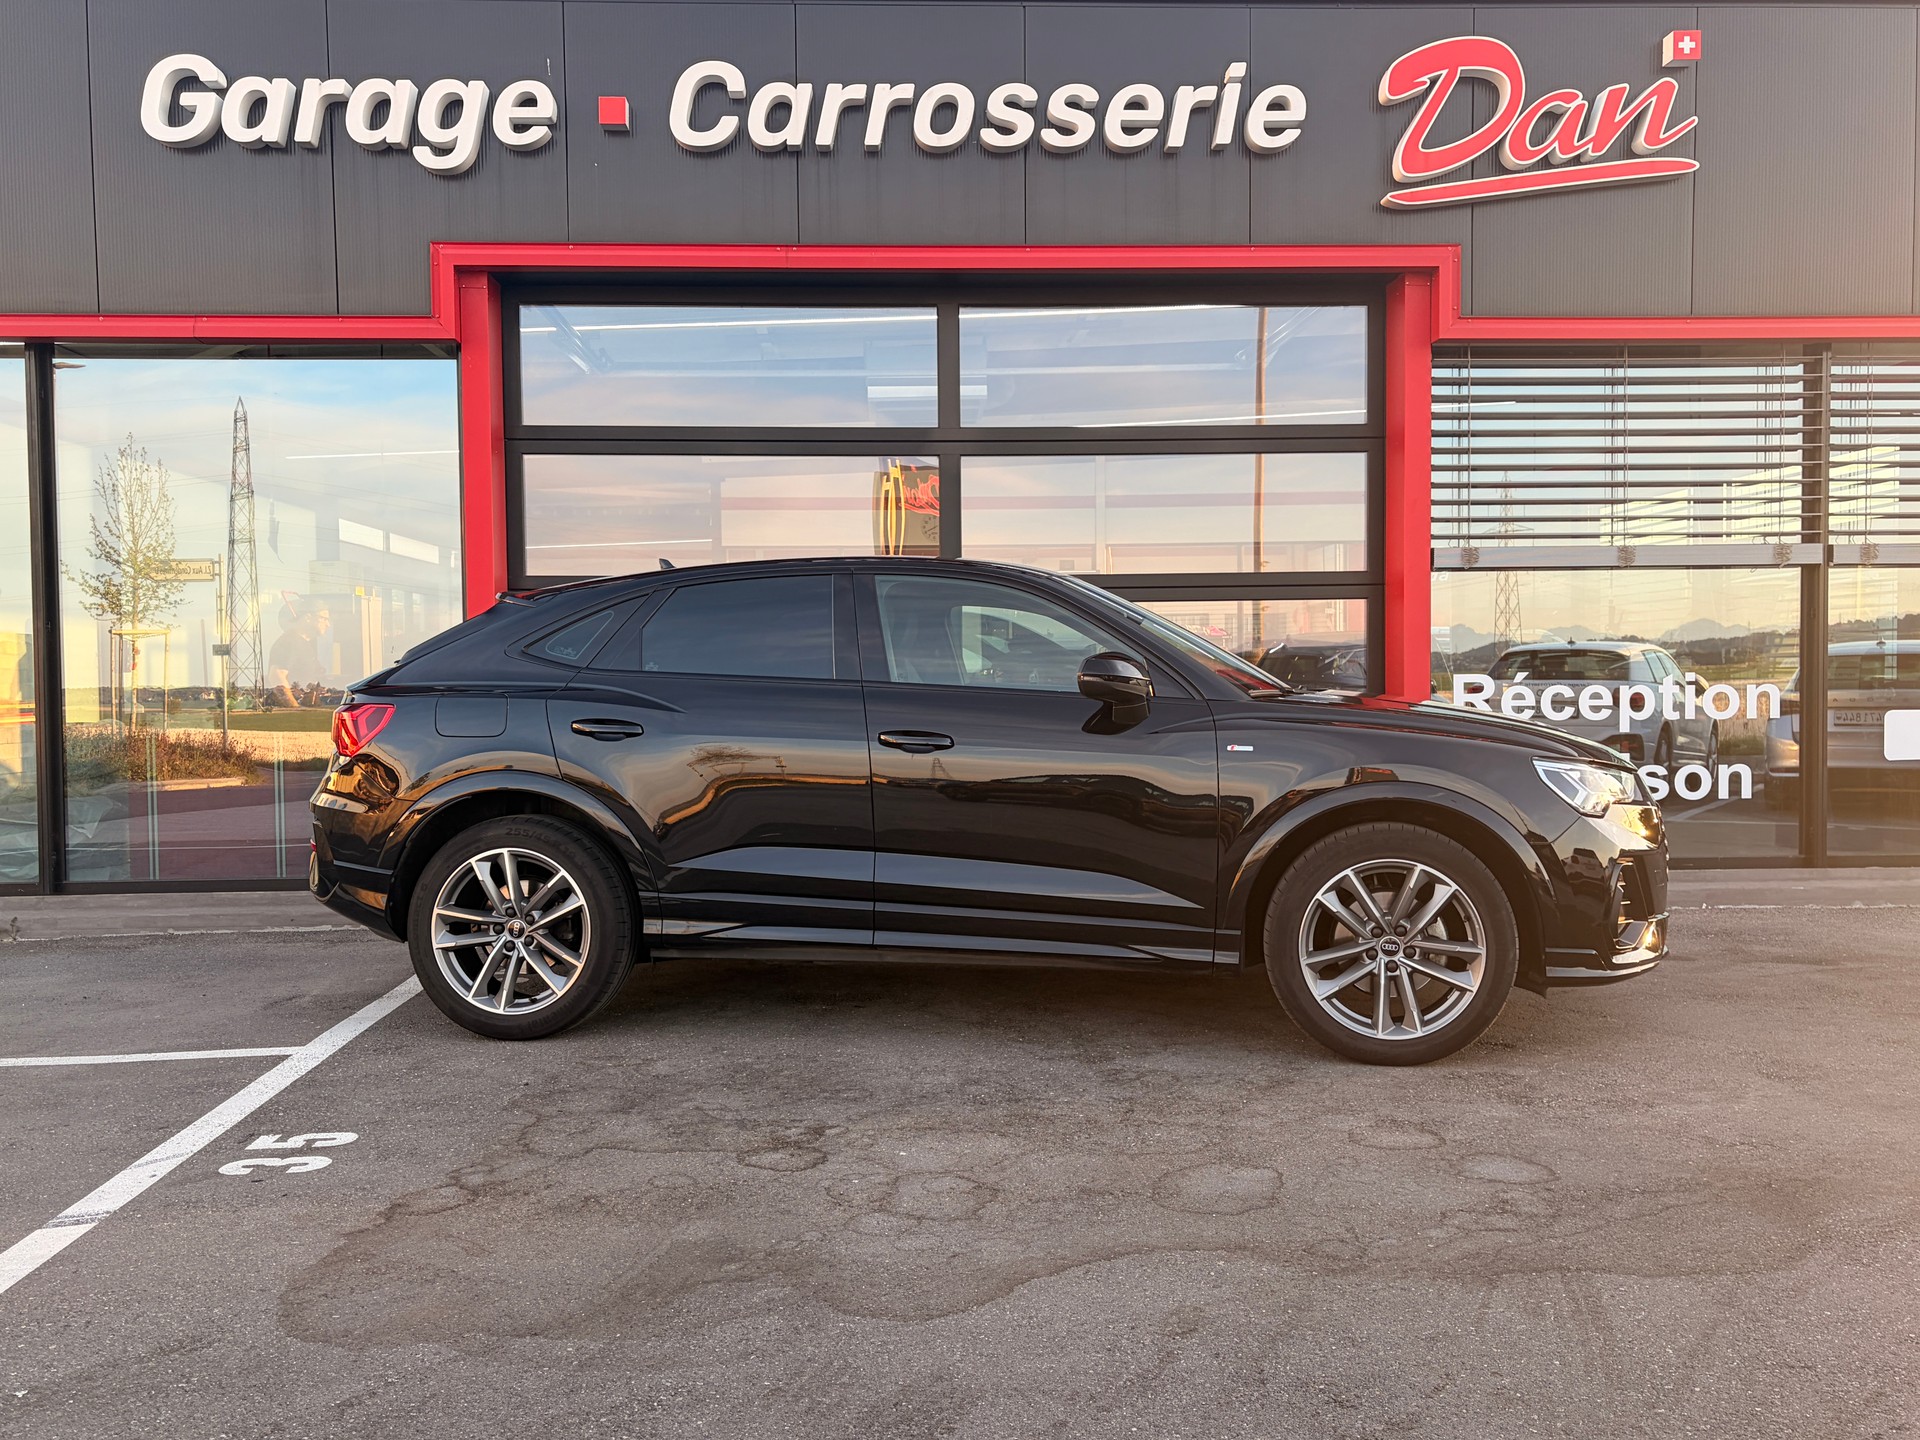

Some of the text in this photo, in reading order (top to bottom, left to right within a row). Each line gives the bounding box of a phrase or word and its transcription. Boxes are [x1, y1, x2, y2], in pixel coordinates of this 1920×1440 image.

[141, 36, 1699, 183] Garage Carrosserie Dan
[1452, 672, 1781, 732] Réception
[1620, 752, 1752, 801] son
